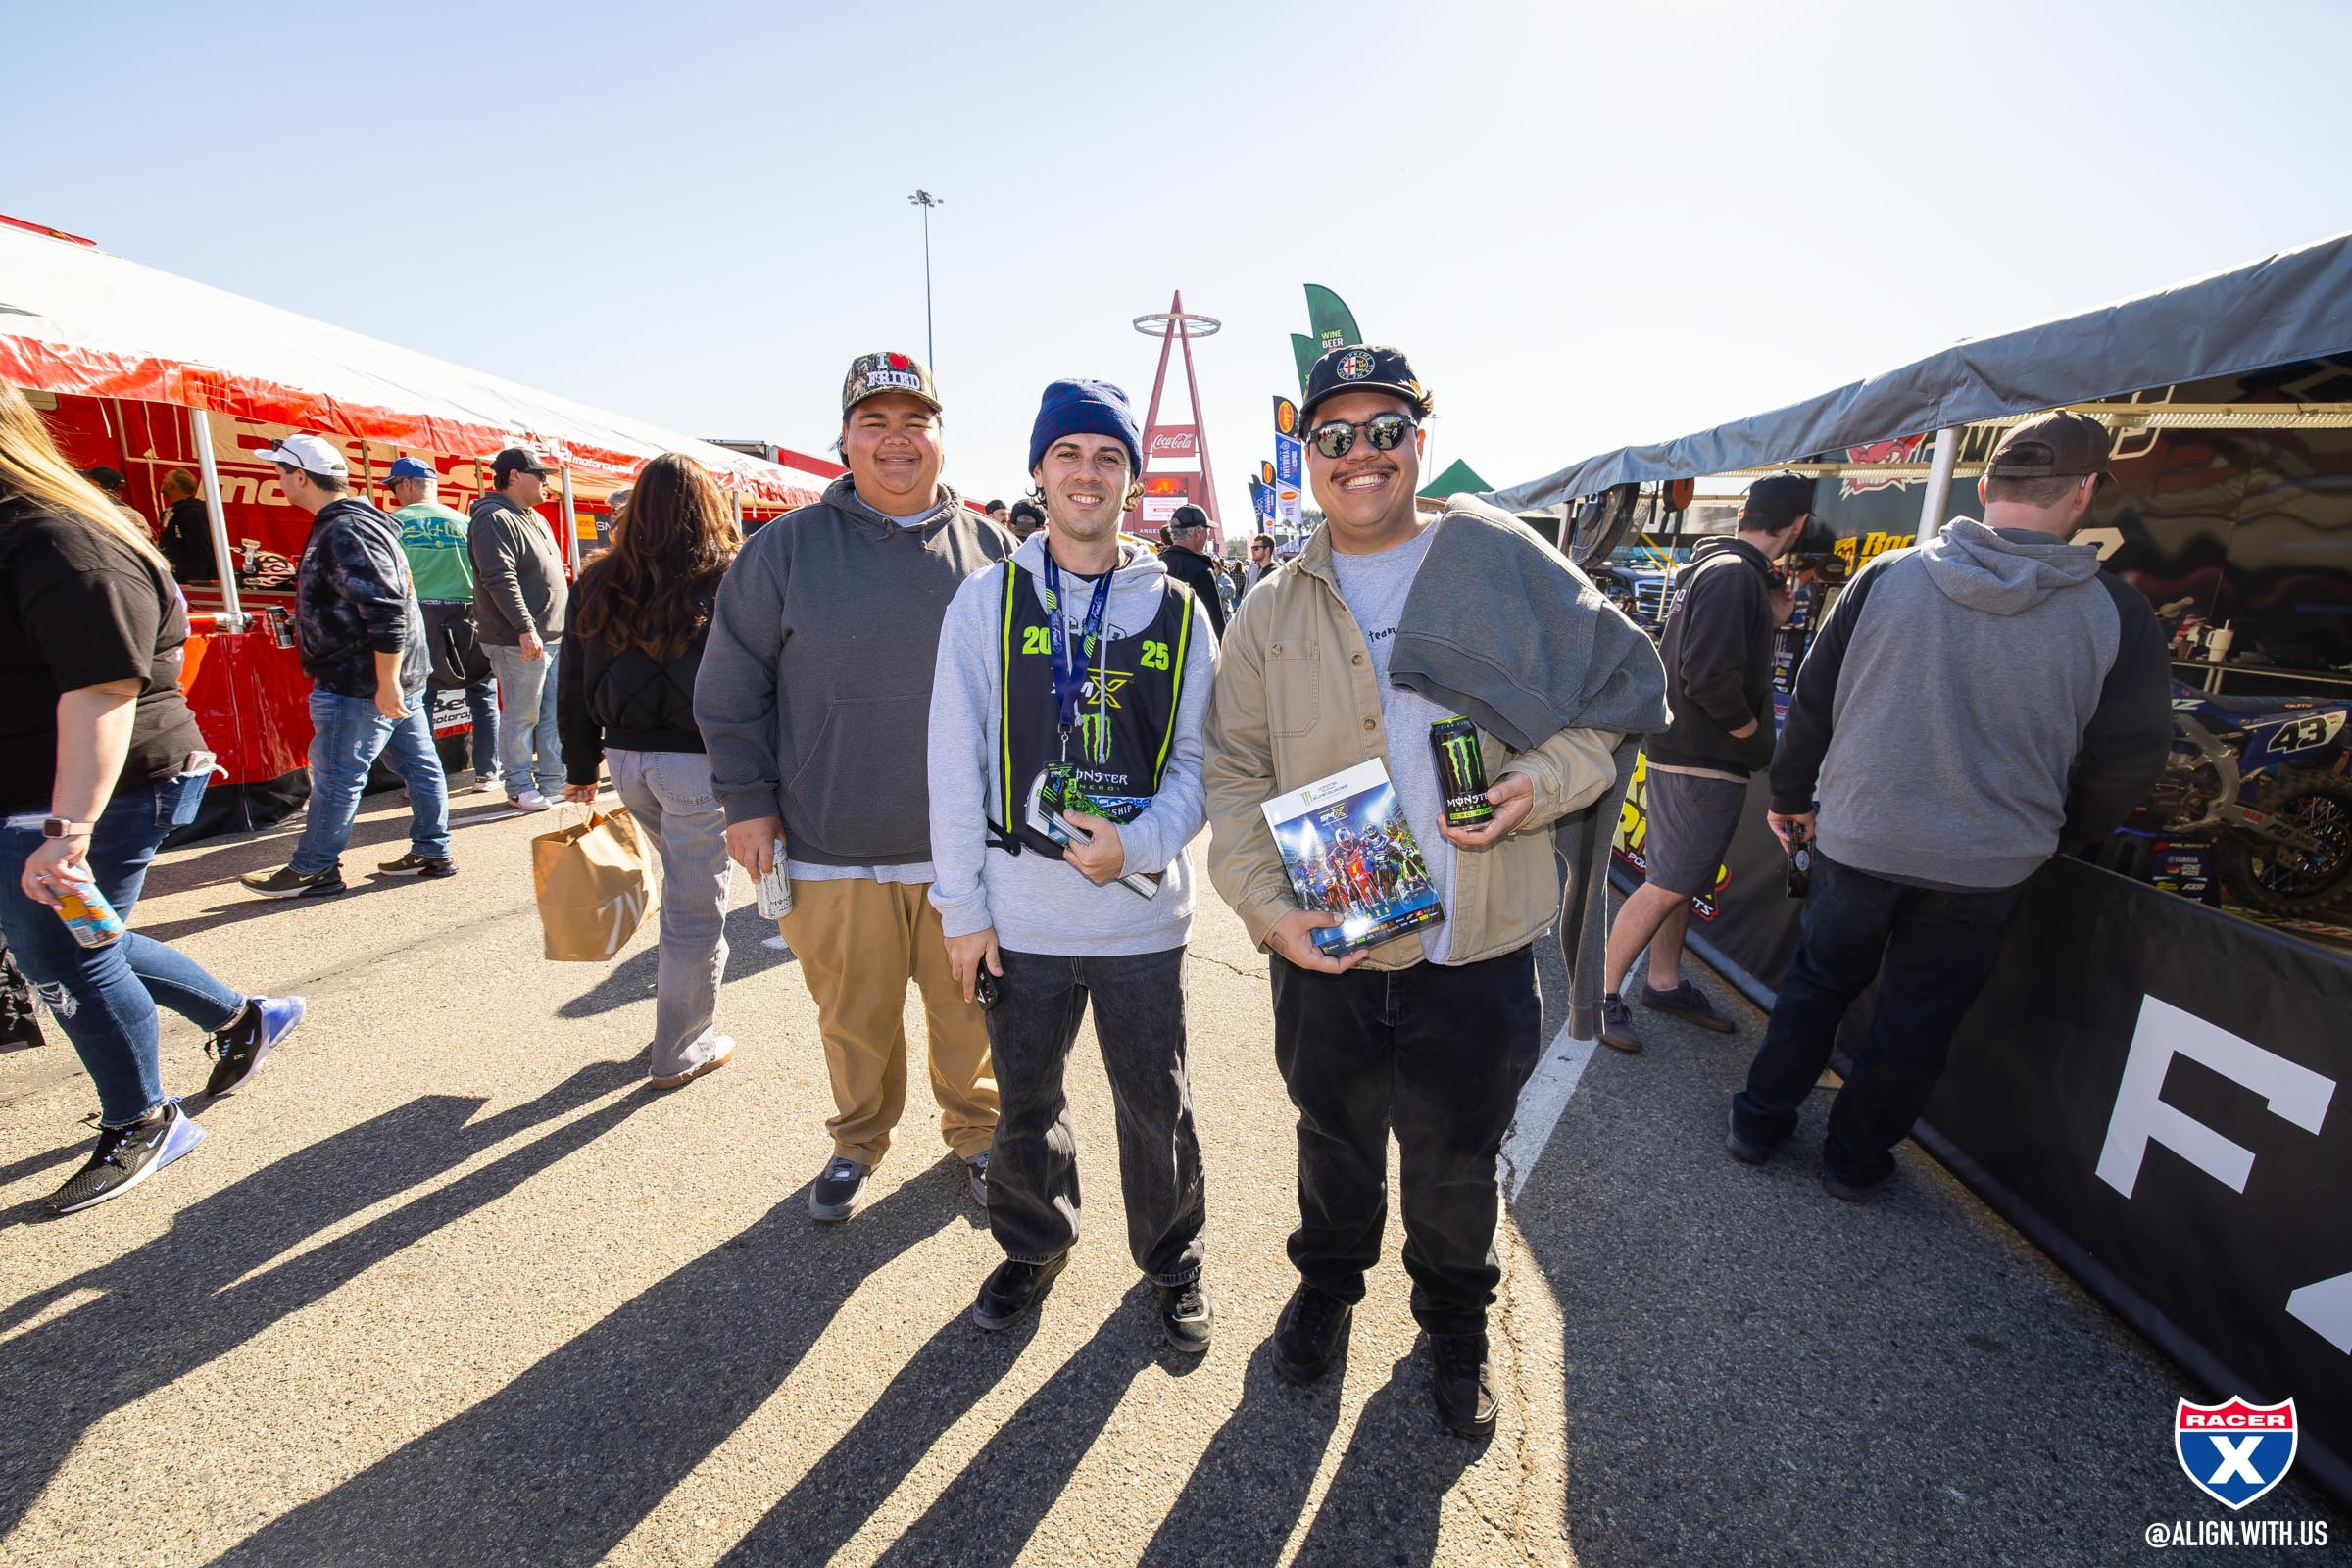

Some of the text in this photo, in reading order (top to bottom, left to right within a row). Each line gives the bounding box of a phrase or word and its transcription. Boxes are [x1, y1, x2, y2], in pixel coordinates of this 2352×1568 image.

[1320, 329, 1343, 339] WINE
[1322, 338, 1344, 349] BEER
[877, 353, 887, 368] I
[866, 370, 920, 390] FRIED
[1282, 450, 1291, 479] YAMAHA
[1022, 626, 1052, 655] 20
[1368, 627, 1396, 643] team
[1140, 640, 1169, 671] 25
[2269, 717, 2328, 752] 43
[1076, 768, 1128, 785] ONSTER
[1446, 792, 1489, 808] MONSTE
[1109, 806, 1132, 817] SHIP
